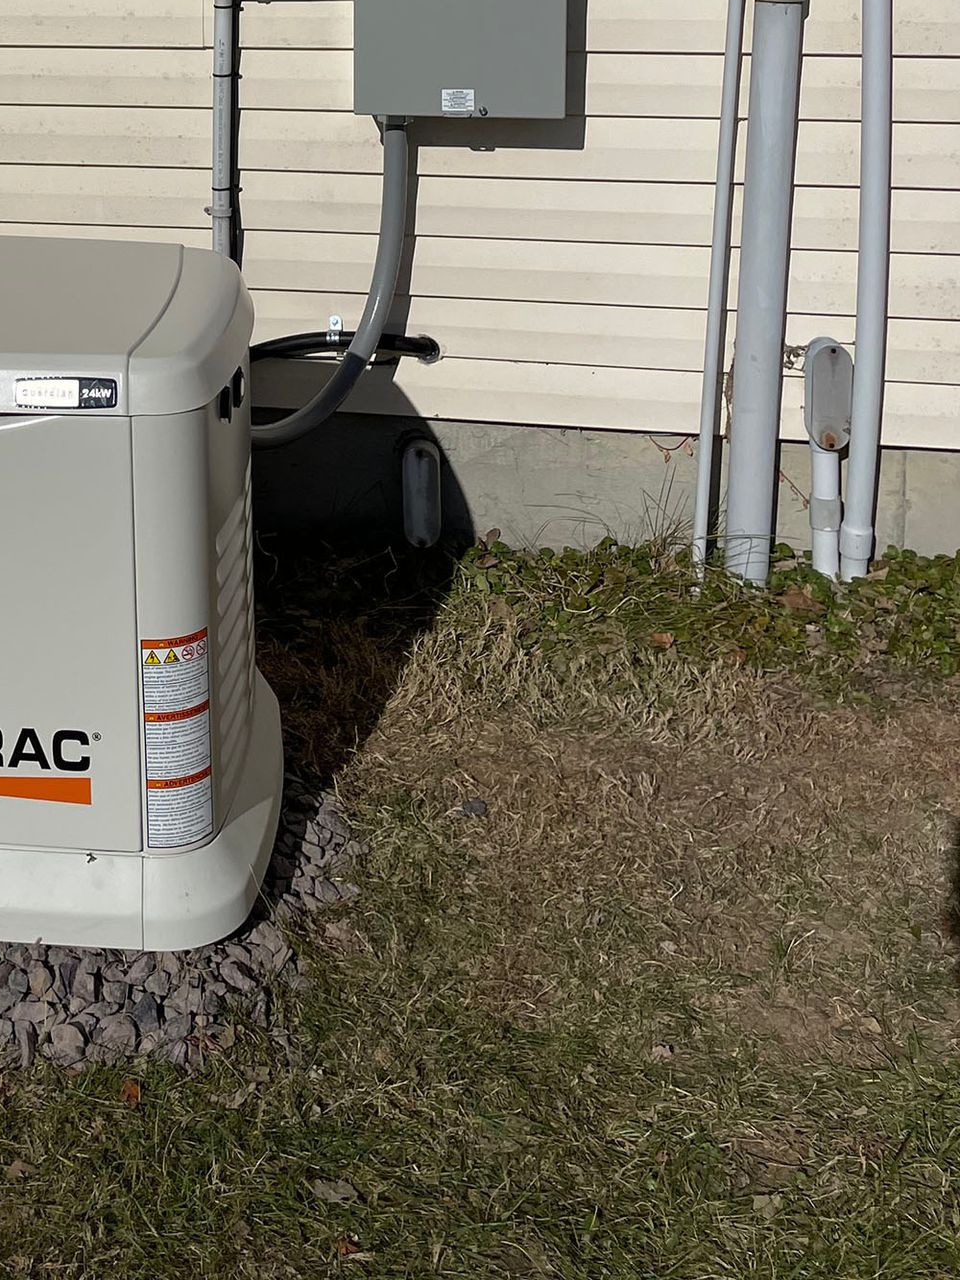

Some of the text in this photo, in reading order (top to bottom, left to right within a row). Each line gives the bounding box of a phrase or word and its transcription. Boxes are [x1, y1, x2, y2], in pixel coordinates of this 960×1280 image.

[81, 388, 112, 399] 24kW
[167, 635, 199, 647] WARNING
[156, 701, 209, 721] AVERTISSE
